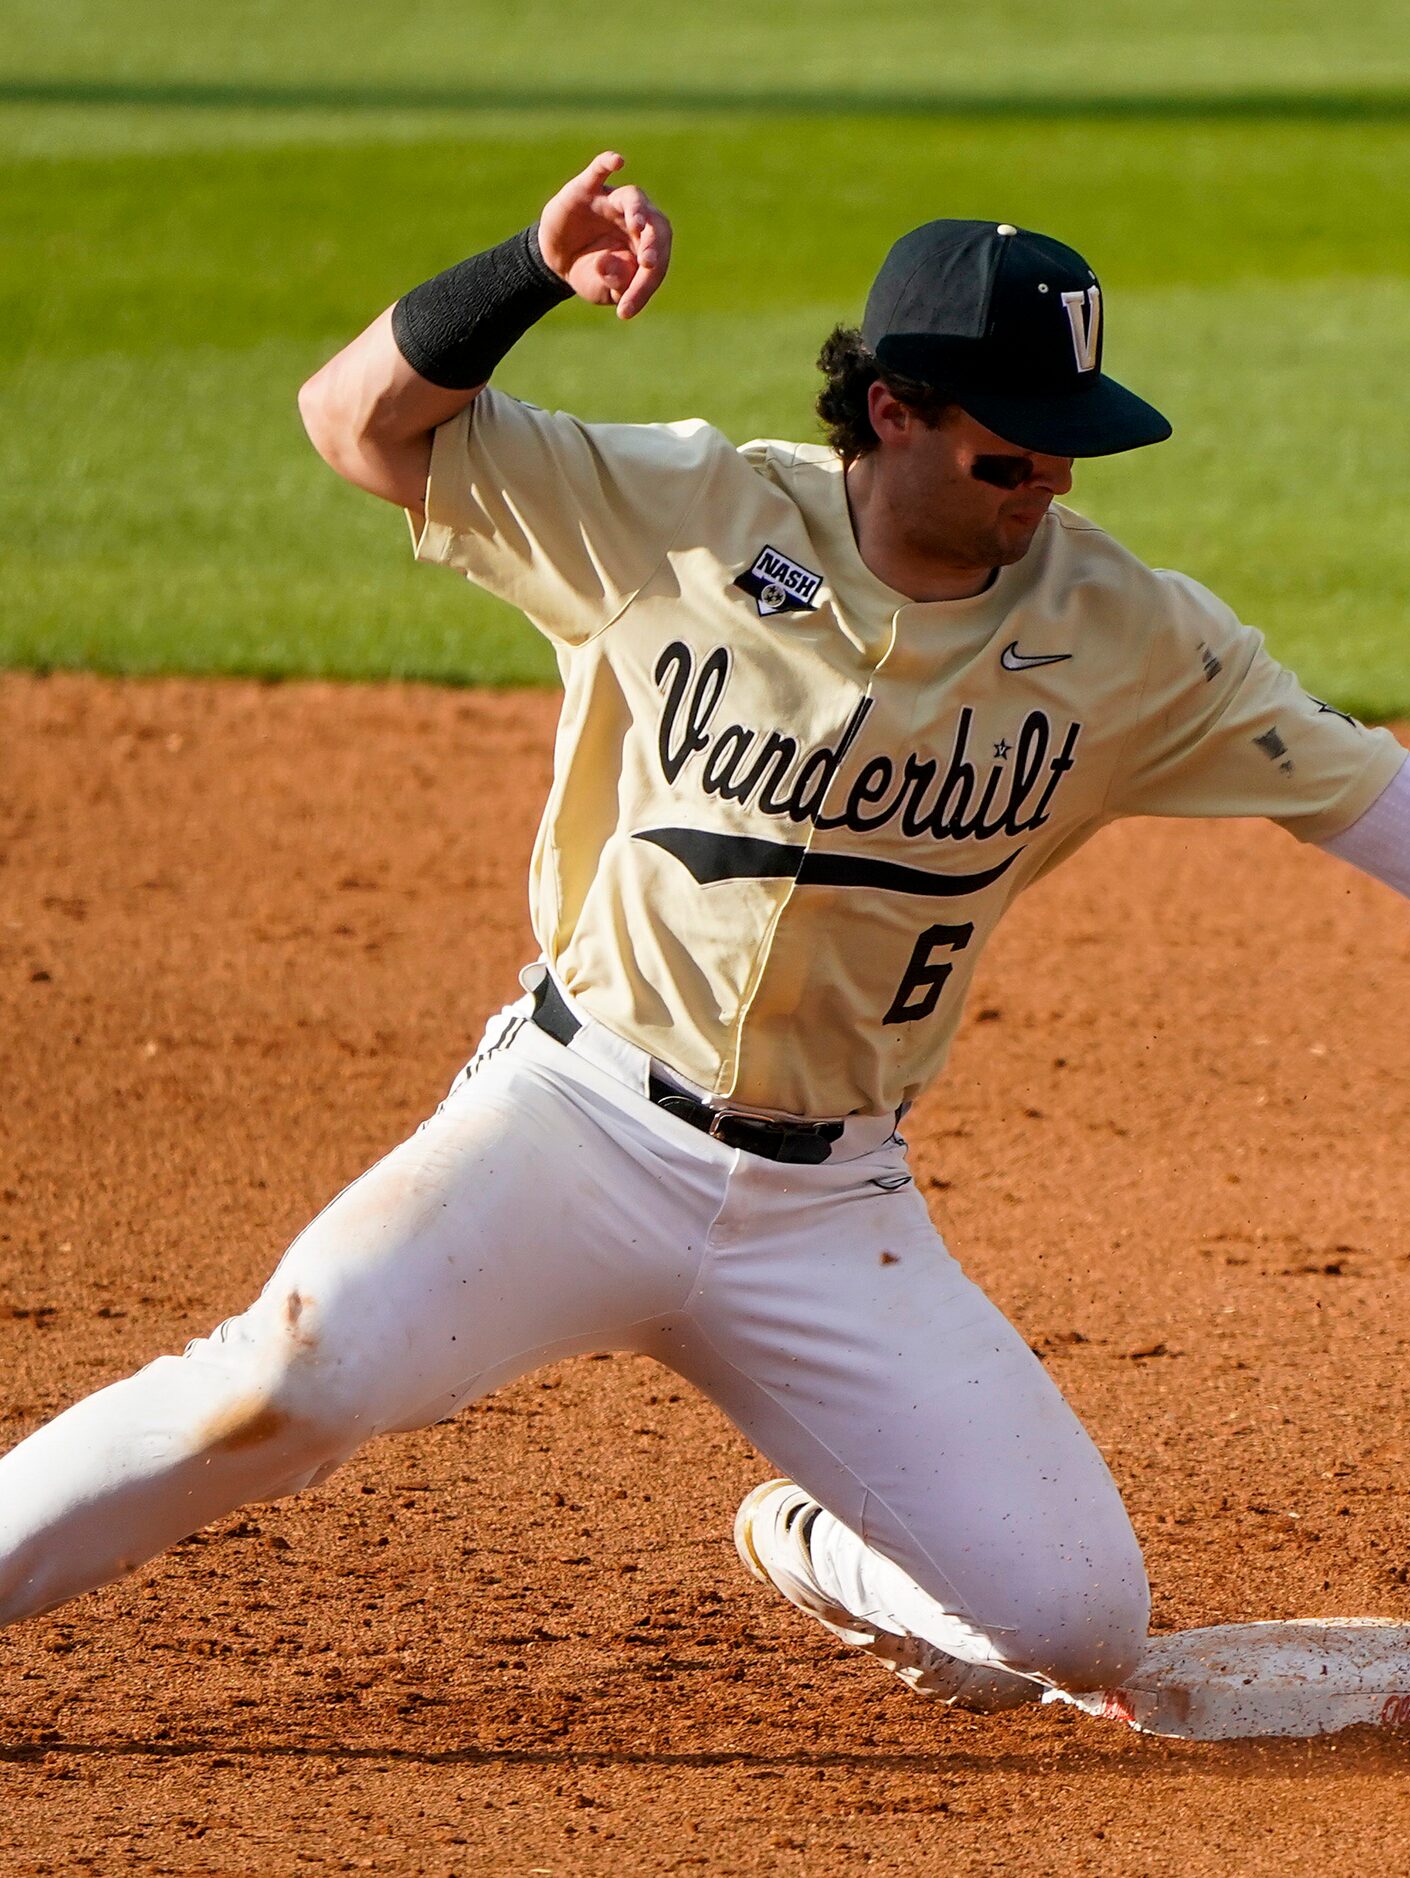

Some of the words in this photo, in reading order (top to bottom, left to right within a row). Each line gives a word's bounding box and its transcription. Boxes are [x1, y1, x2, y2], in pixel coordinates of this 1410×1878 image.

[1060, 284, 1100, 374] V
[756, 552, 817, 598] NASH
[654, 640, 1081, 841] Vanderbilt
[882, 921, 975, 1026] 6
